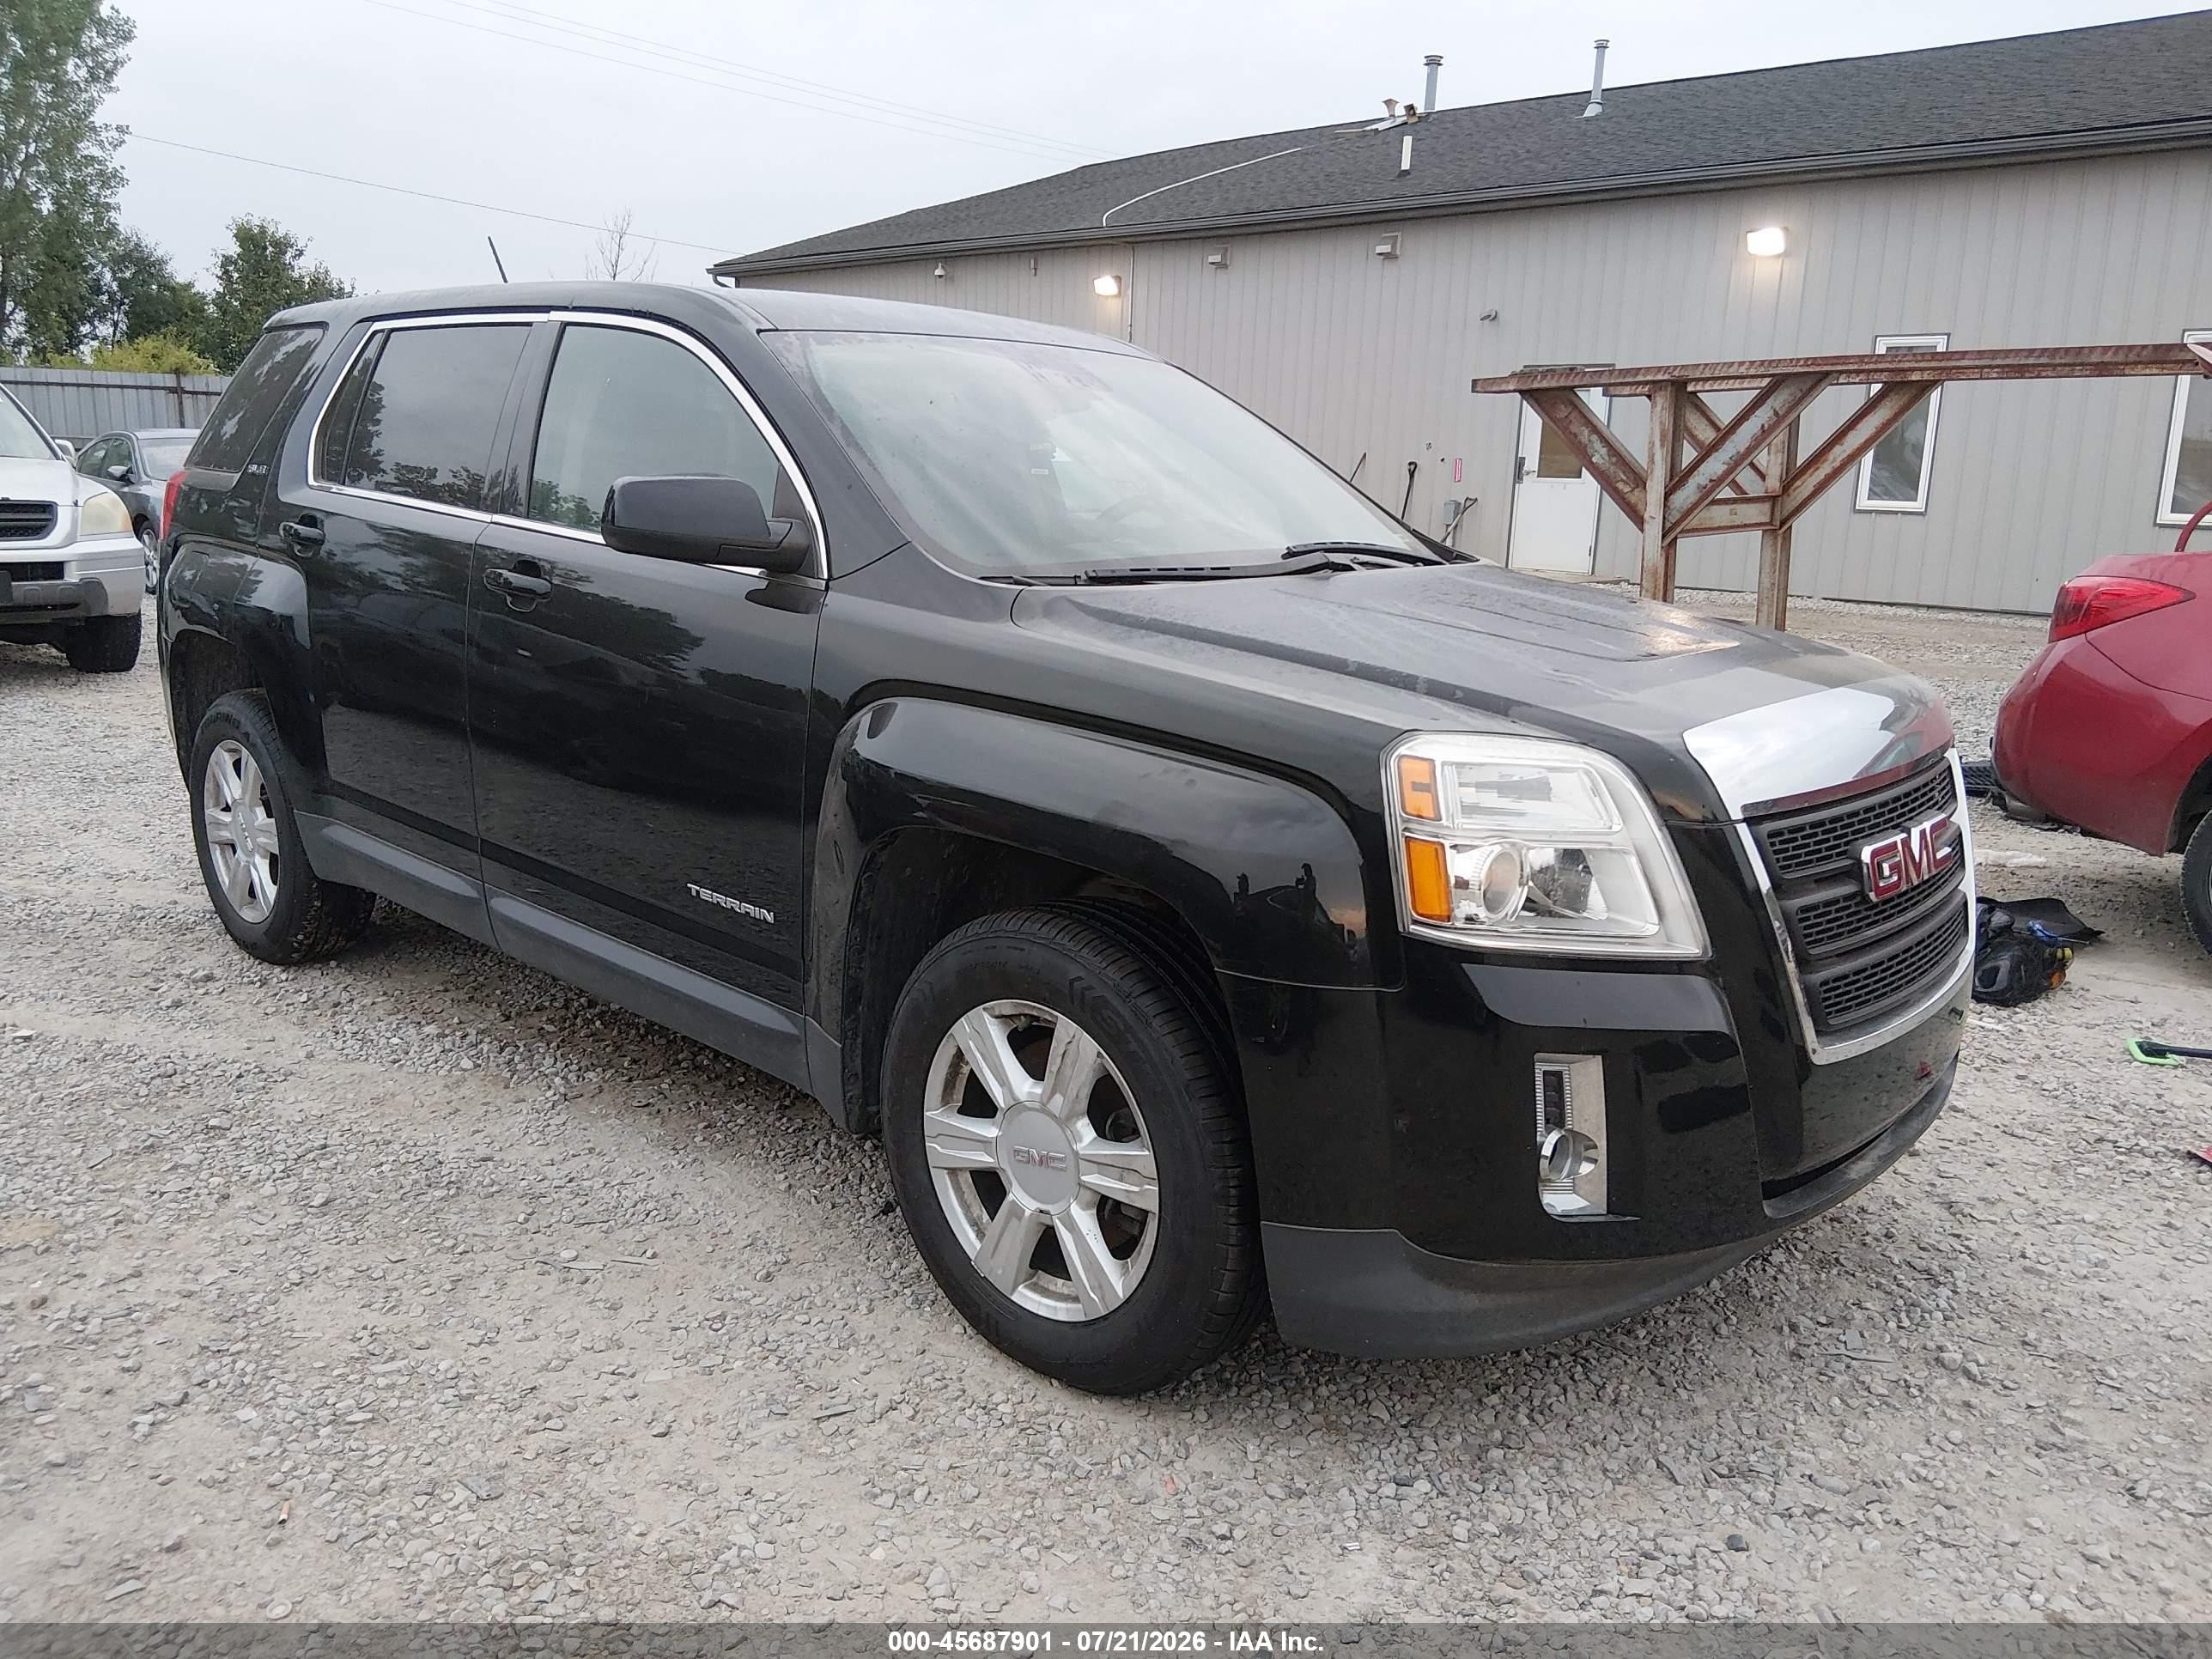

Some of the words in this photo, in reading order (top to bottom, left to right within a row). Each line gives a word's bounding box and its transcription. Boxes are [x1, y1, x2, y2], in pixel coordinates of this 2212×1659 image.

[1861, 814, 1953, 902] GMC
[686, 883, 775, 924] TERRAIN
[1013, 1146, 1066, 1171] GMC
